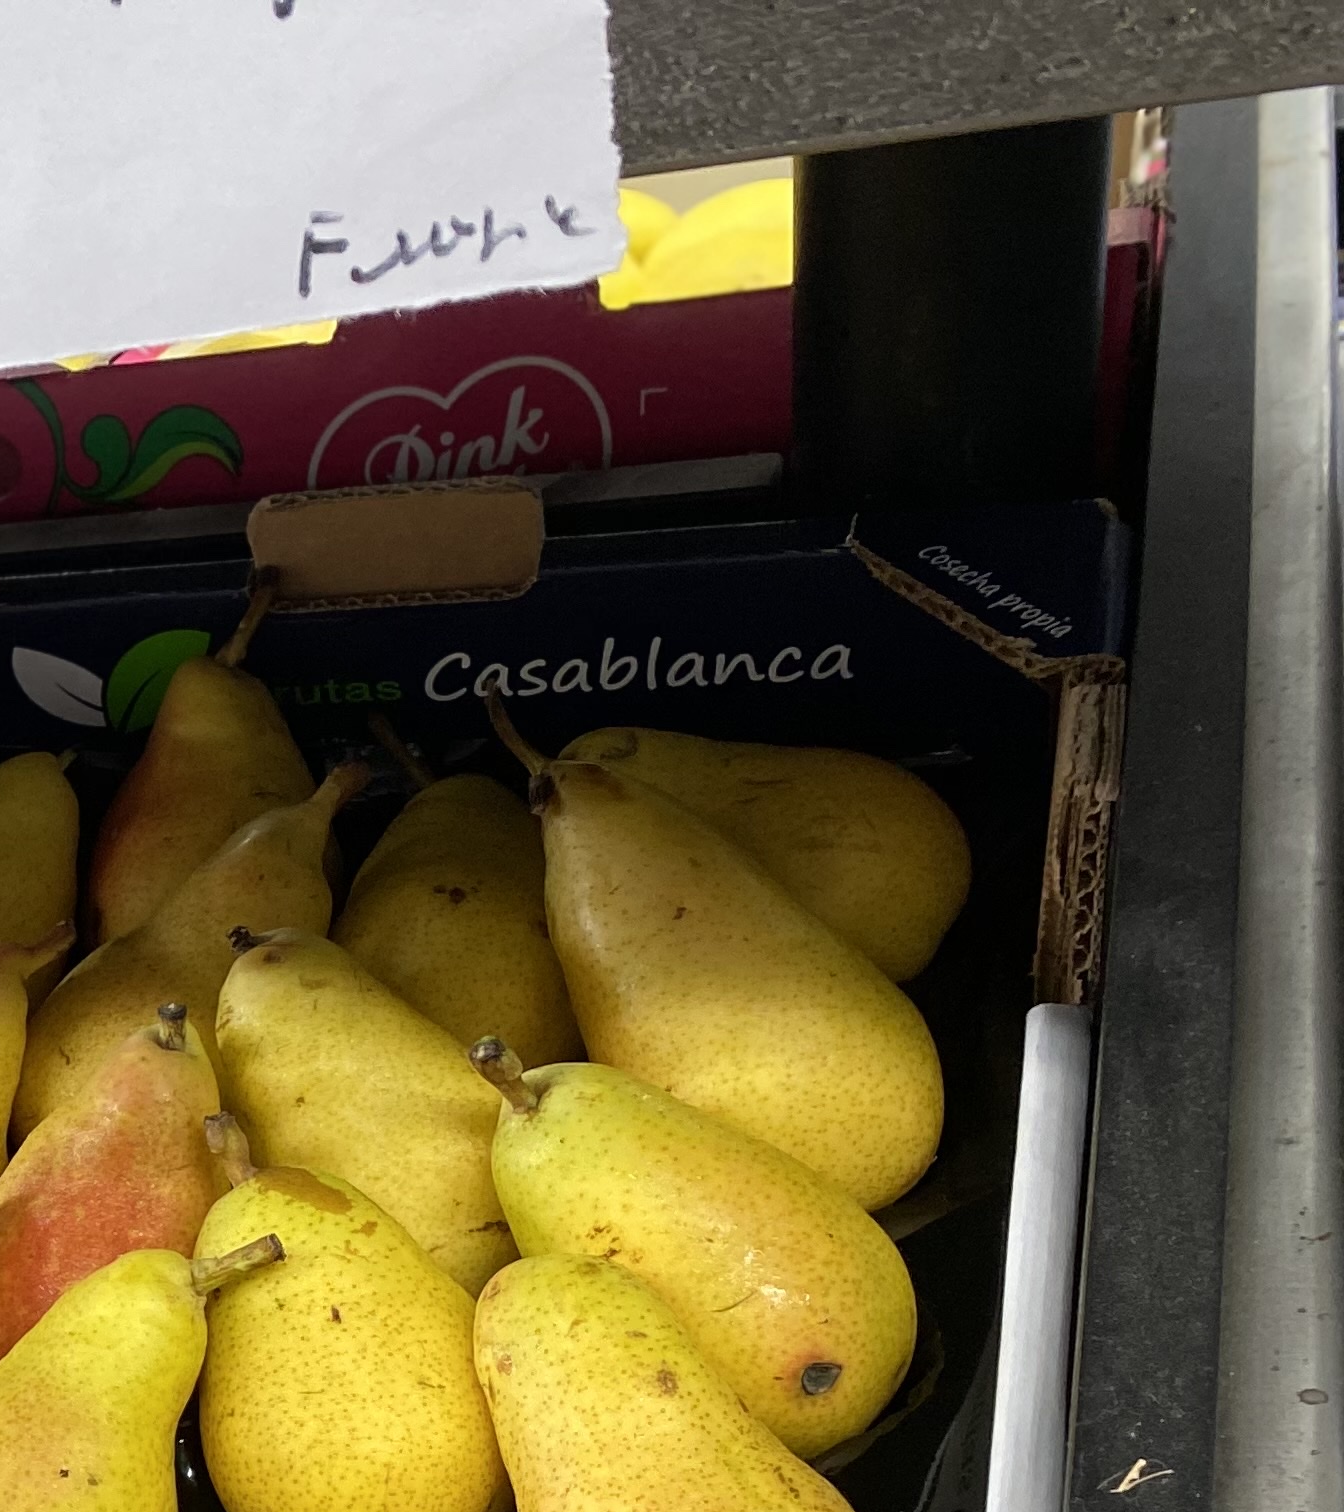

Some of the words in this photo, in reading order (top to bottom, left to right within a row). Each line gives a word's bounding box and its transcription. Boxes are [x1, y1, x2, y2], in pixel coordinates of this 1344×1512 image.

[365, 384, 549, 483] Pink
[918, 545, 1002, 598] Cosecha
[987, 593, 1073, 639] propia
[272, 678, 404, 707] rutas
[423, 636, 856, 702] Casablanca
